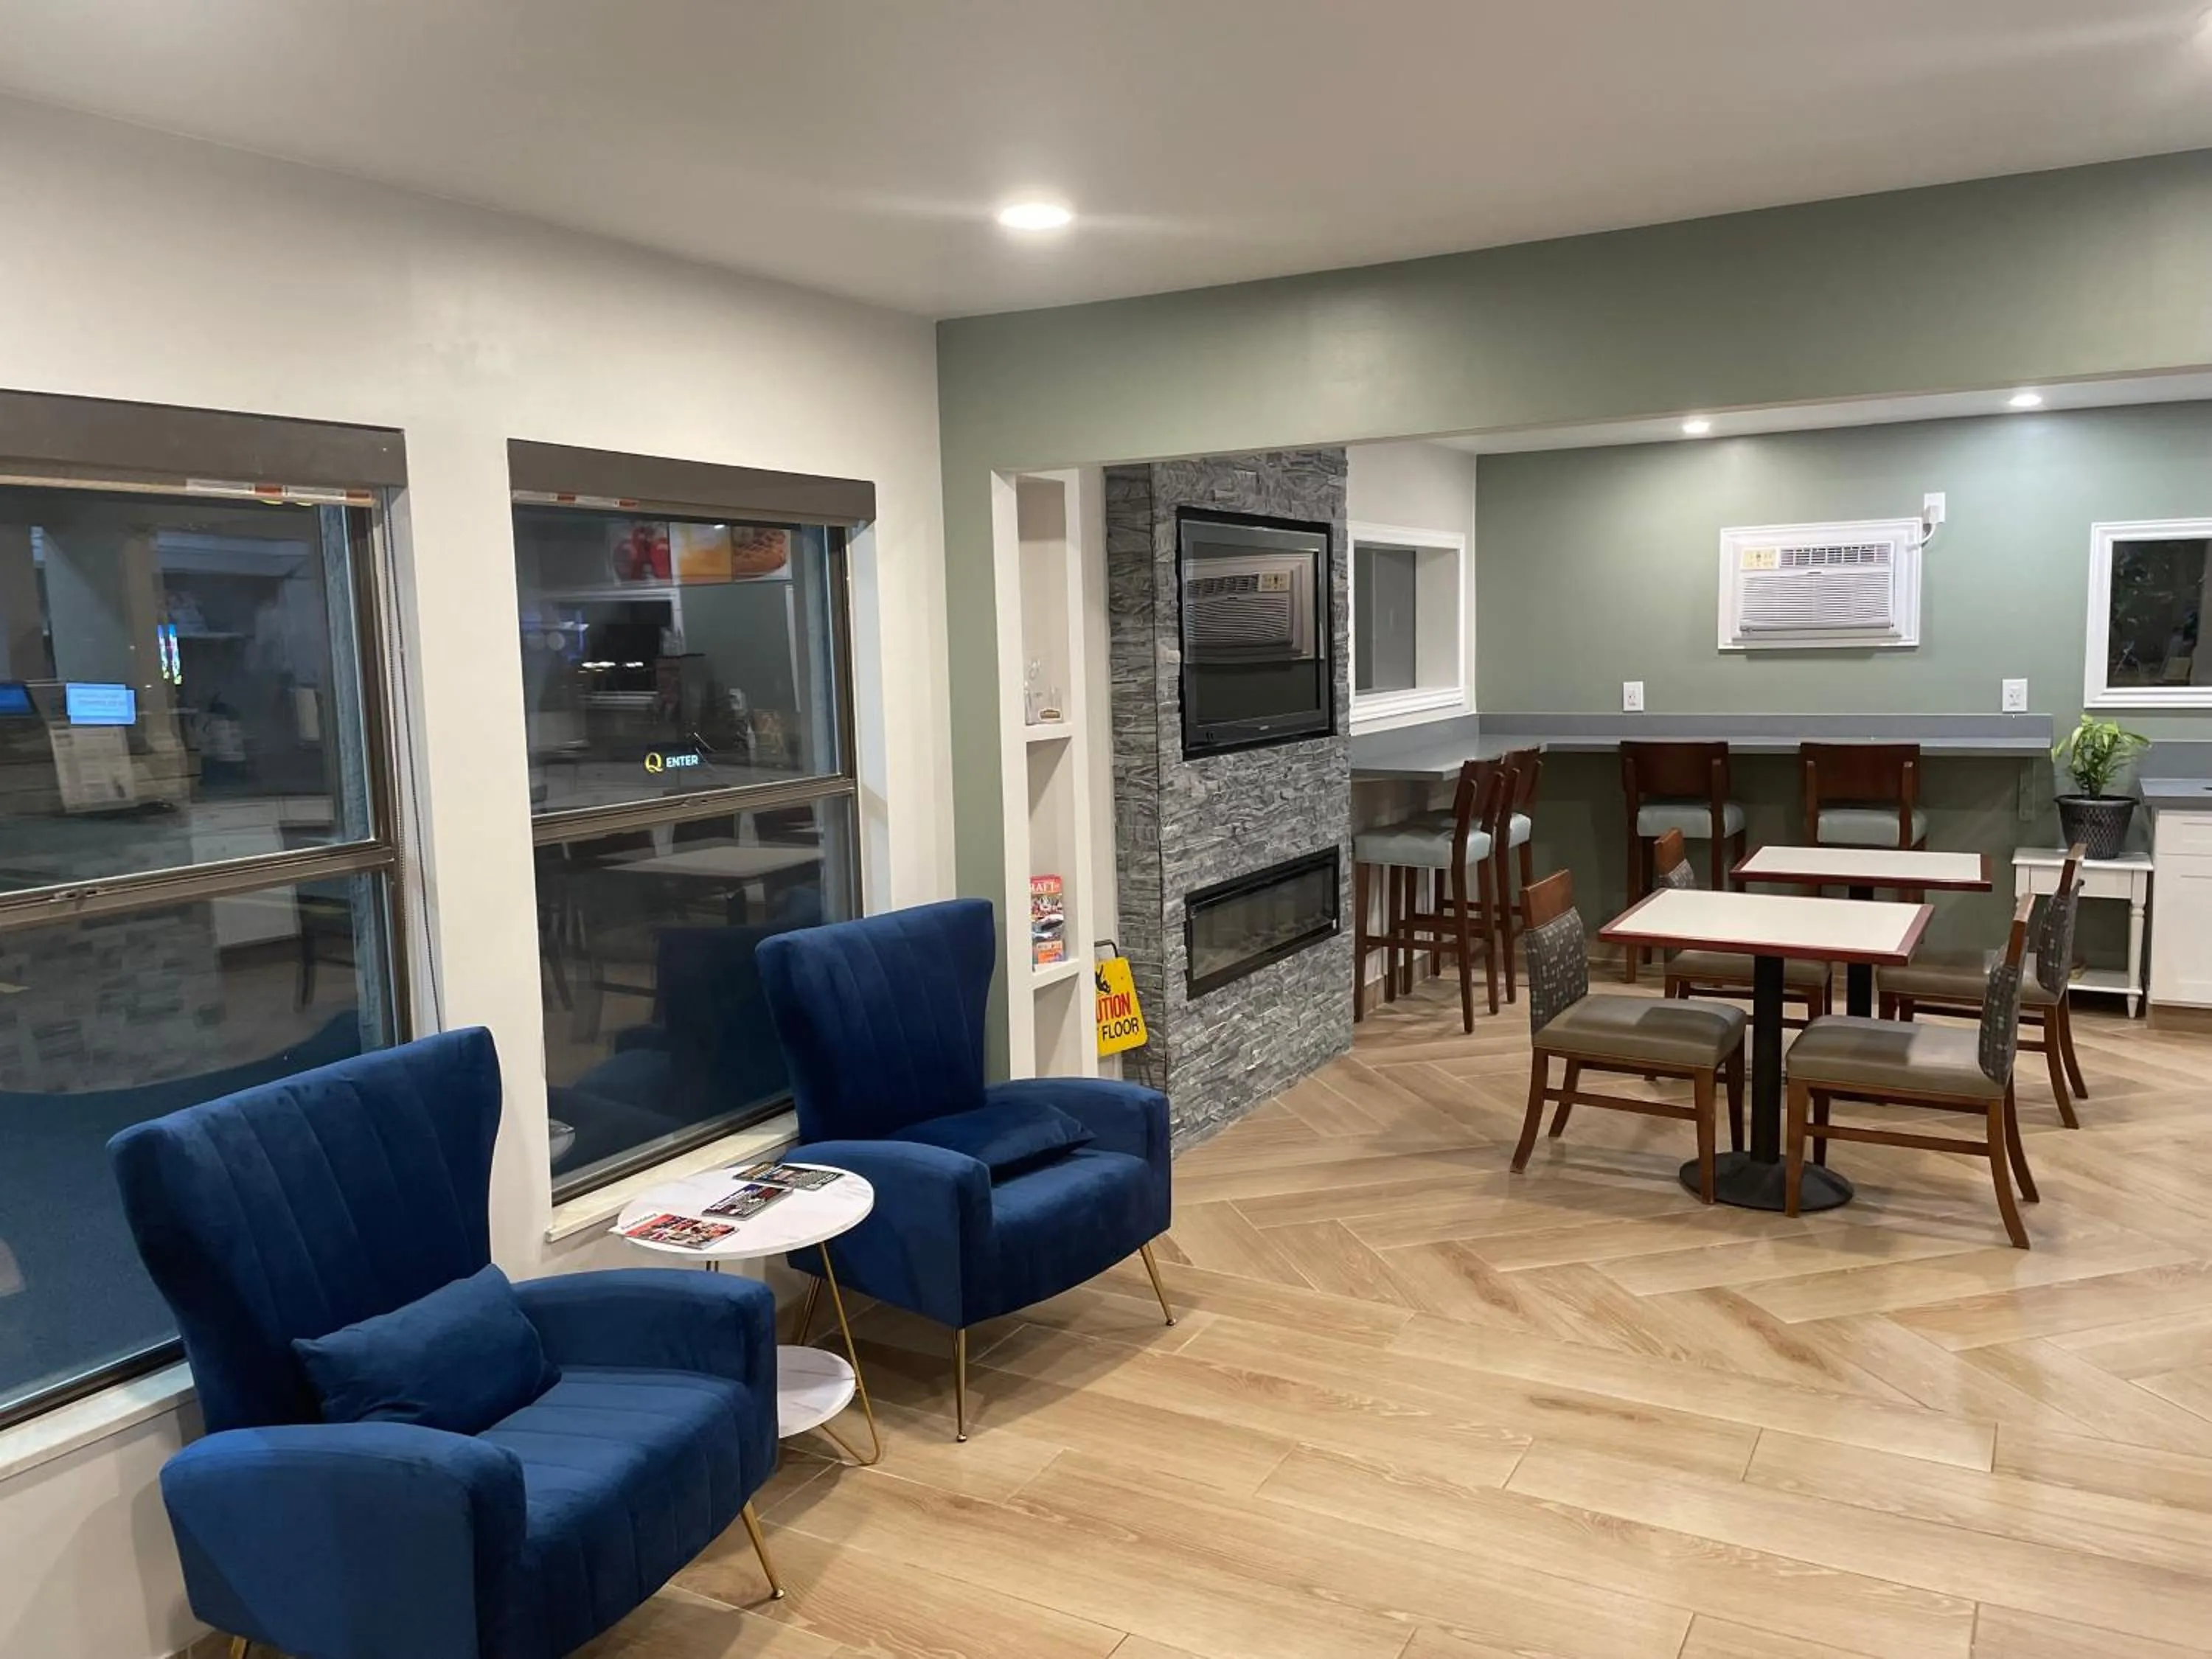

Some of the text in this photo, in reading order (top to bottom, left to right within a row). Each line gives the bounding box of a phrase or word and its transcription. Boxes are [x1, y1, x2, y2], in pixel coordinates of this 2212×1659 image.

[644, 752, 699, 773] Q ENTER
[1097, 992, 1131, 1023] UTION
[1102, 1017, 1139, 1041] FLOOR
